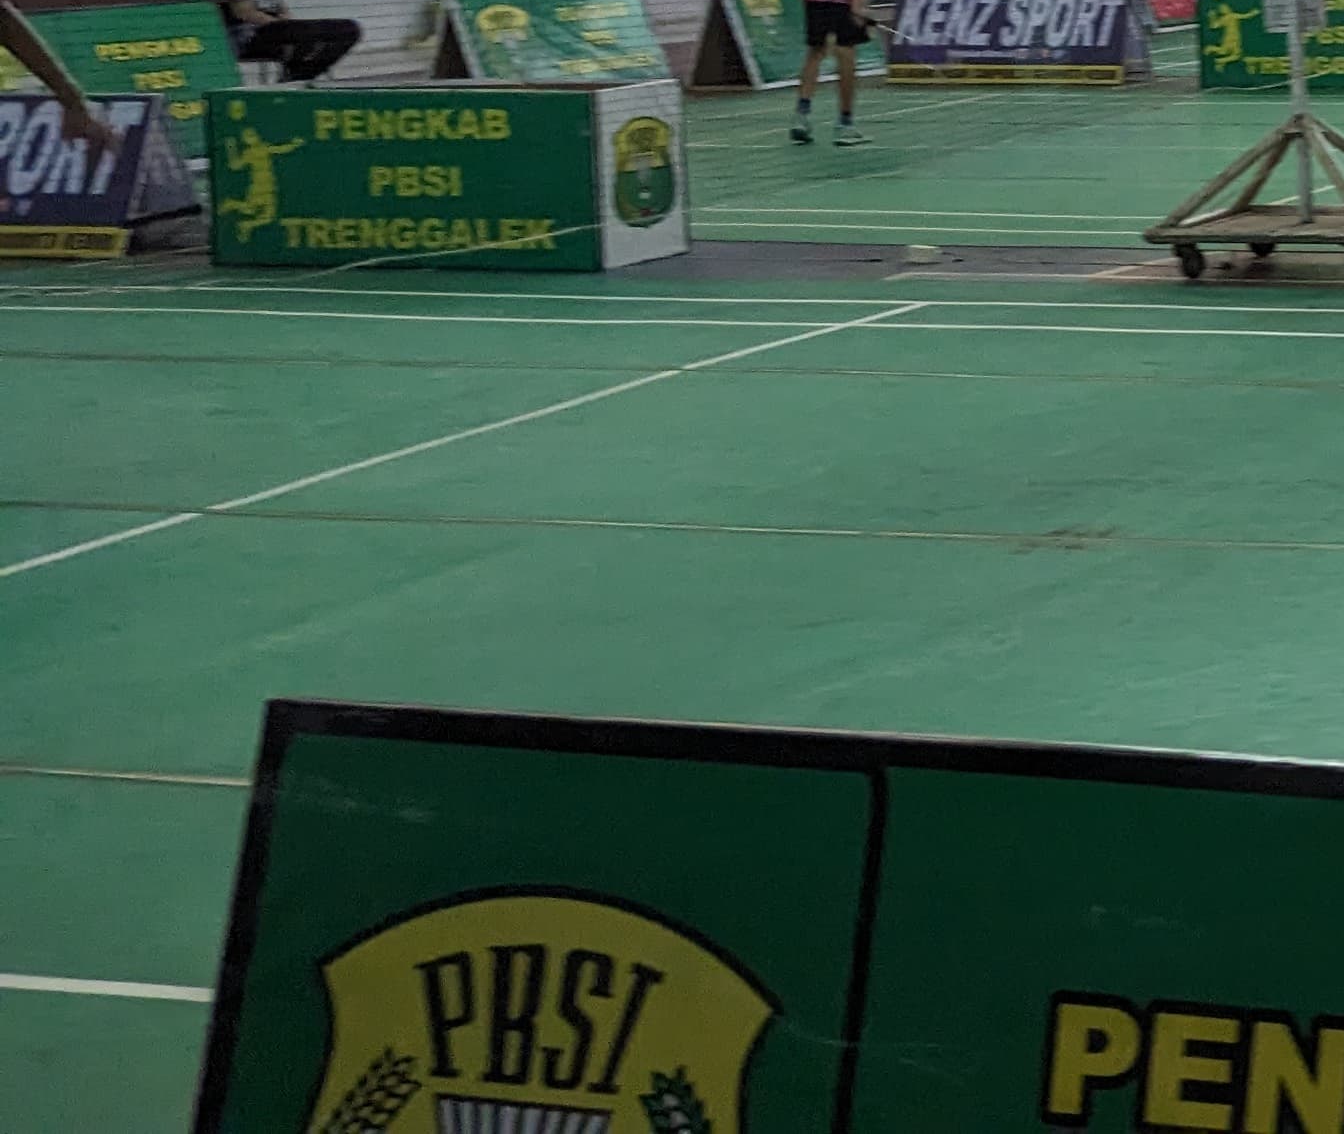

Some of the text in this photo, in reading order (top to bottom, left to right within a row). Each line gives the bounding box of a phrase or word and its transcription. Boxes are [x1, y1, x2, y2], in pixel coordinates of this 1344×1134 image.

[313, 109, 511, 141] PENGKAB
[368, 166, 462, 197] PBSI
[280, 218, 557, 250] TRENGGALEK
[413, 942, 667, 1096] PBSI
